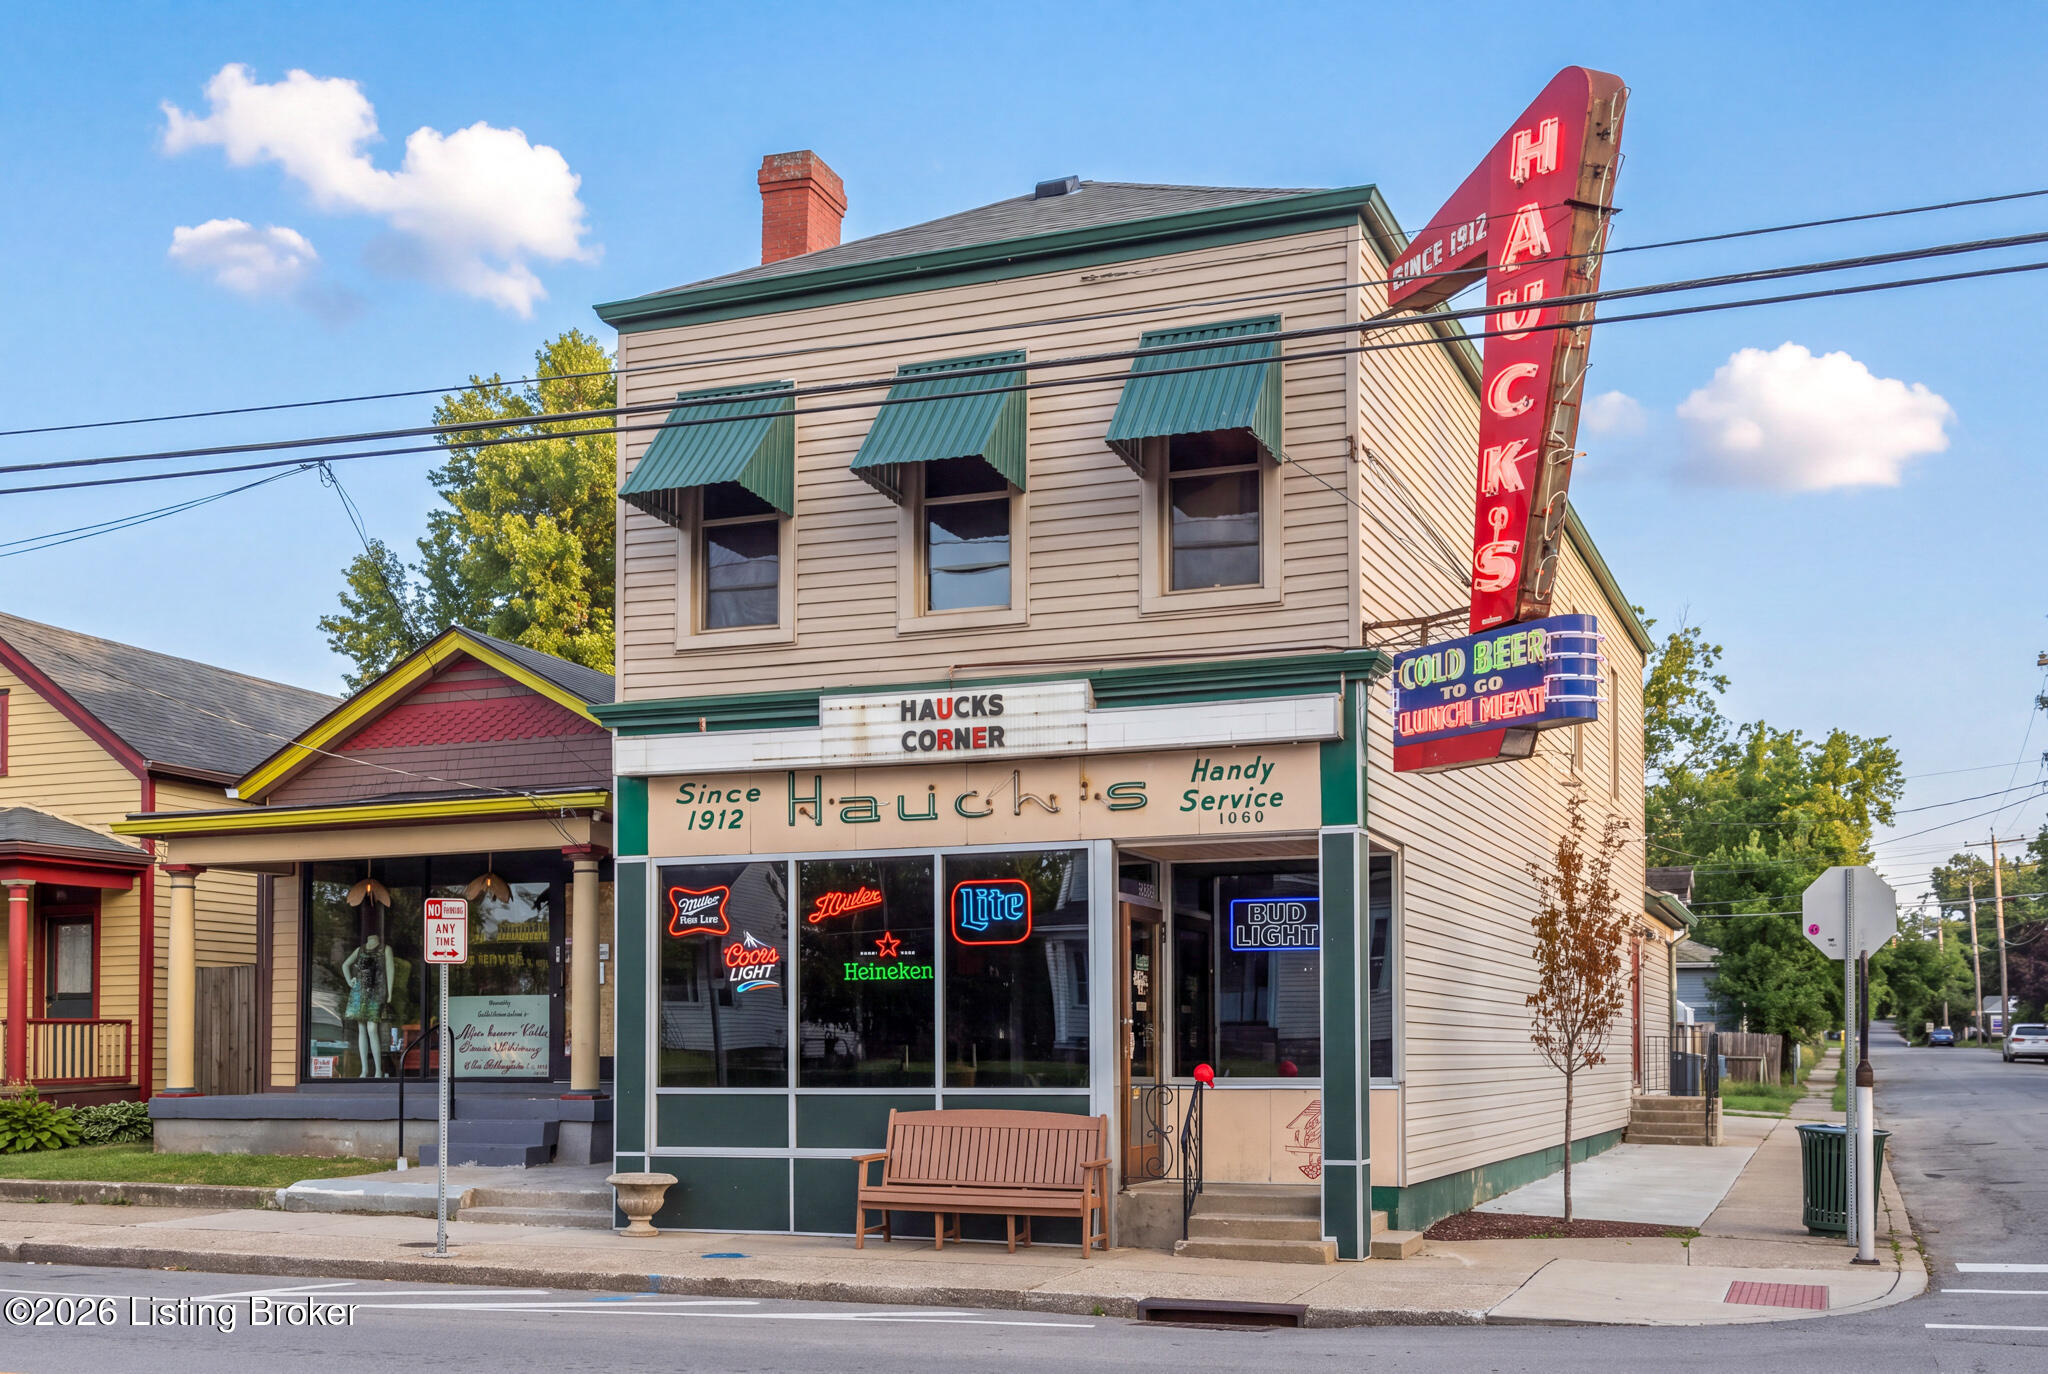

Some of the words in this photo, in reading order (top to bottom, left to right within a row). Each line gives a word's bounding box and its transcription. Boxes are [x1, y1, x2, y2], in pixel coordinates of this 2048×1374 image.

[1392, 239, 1443, 292] SINCE
[1448, 212, 1488, 258] 1912
[1399, 648, 1466, 690] COLD
[1473, 628, 1548, 675] BEER
[1440, 683, 1467, 700] TO
[1473, 676, 1504, 694] GO
[900, 694, 1005, 722] HAUCKS
[1399, 698, 1473, 737] LUNCH
[1478, 685, 1547, 723] MEAT
[900, 726, 1006, 752] CORNER
[1190, 756, 1275, 785] Handy
[676, 782, 761, 804] Since
[1179, 787, 1284, 812] Service
[688, 808, 744, 831] 1912
[1219, 811, 1264, 824] 1060
[428, 904, 441, 917] NO
[961, 888, 1024, 932] Lite
[1248, 903, 1307, 924] BUD
[435, 923, 456, 934] ANY
[1236, 924, 1319, 946] LIGHT
[435, 937, 456, 947] TIME
[724, 943, 779, 967] Coors
[730, 964, 775, 982] LIGHT
[843, 962, 934, 981] Heineken
